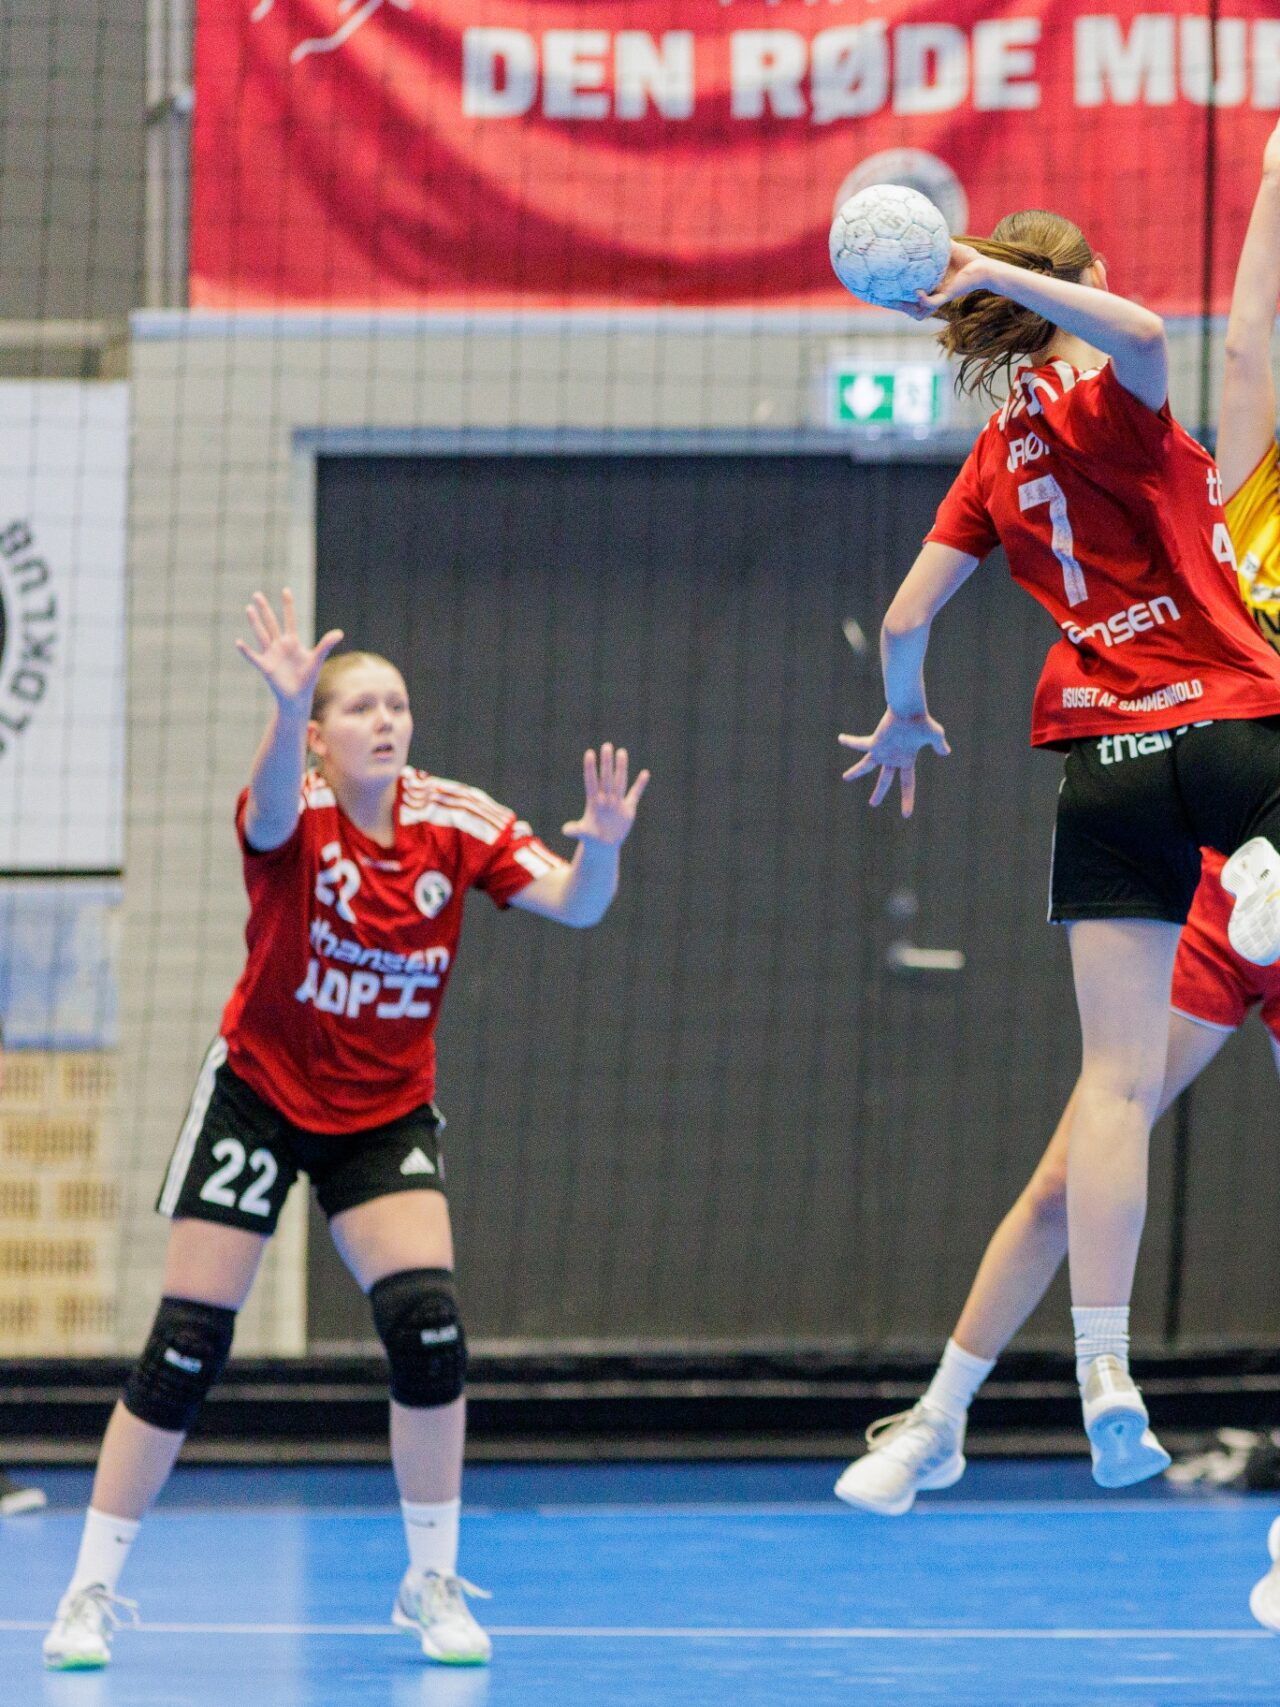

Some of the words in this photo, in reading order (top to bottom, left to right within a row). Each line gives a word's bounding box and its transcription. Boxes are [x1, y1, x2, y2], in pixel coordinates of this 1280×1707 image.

[462, 27, 695, 120] DEN
[730, 17, 1041, 124] RØDE
[1018, 473, 1089, 608] 7
[1098, 691, 1118, 708] AF
[1118, 679, 1203, 712] SAMMENHOLD
[200, 1137, 278, 1217] 22
